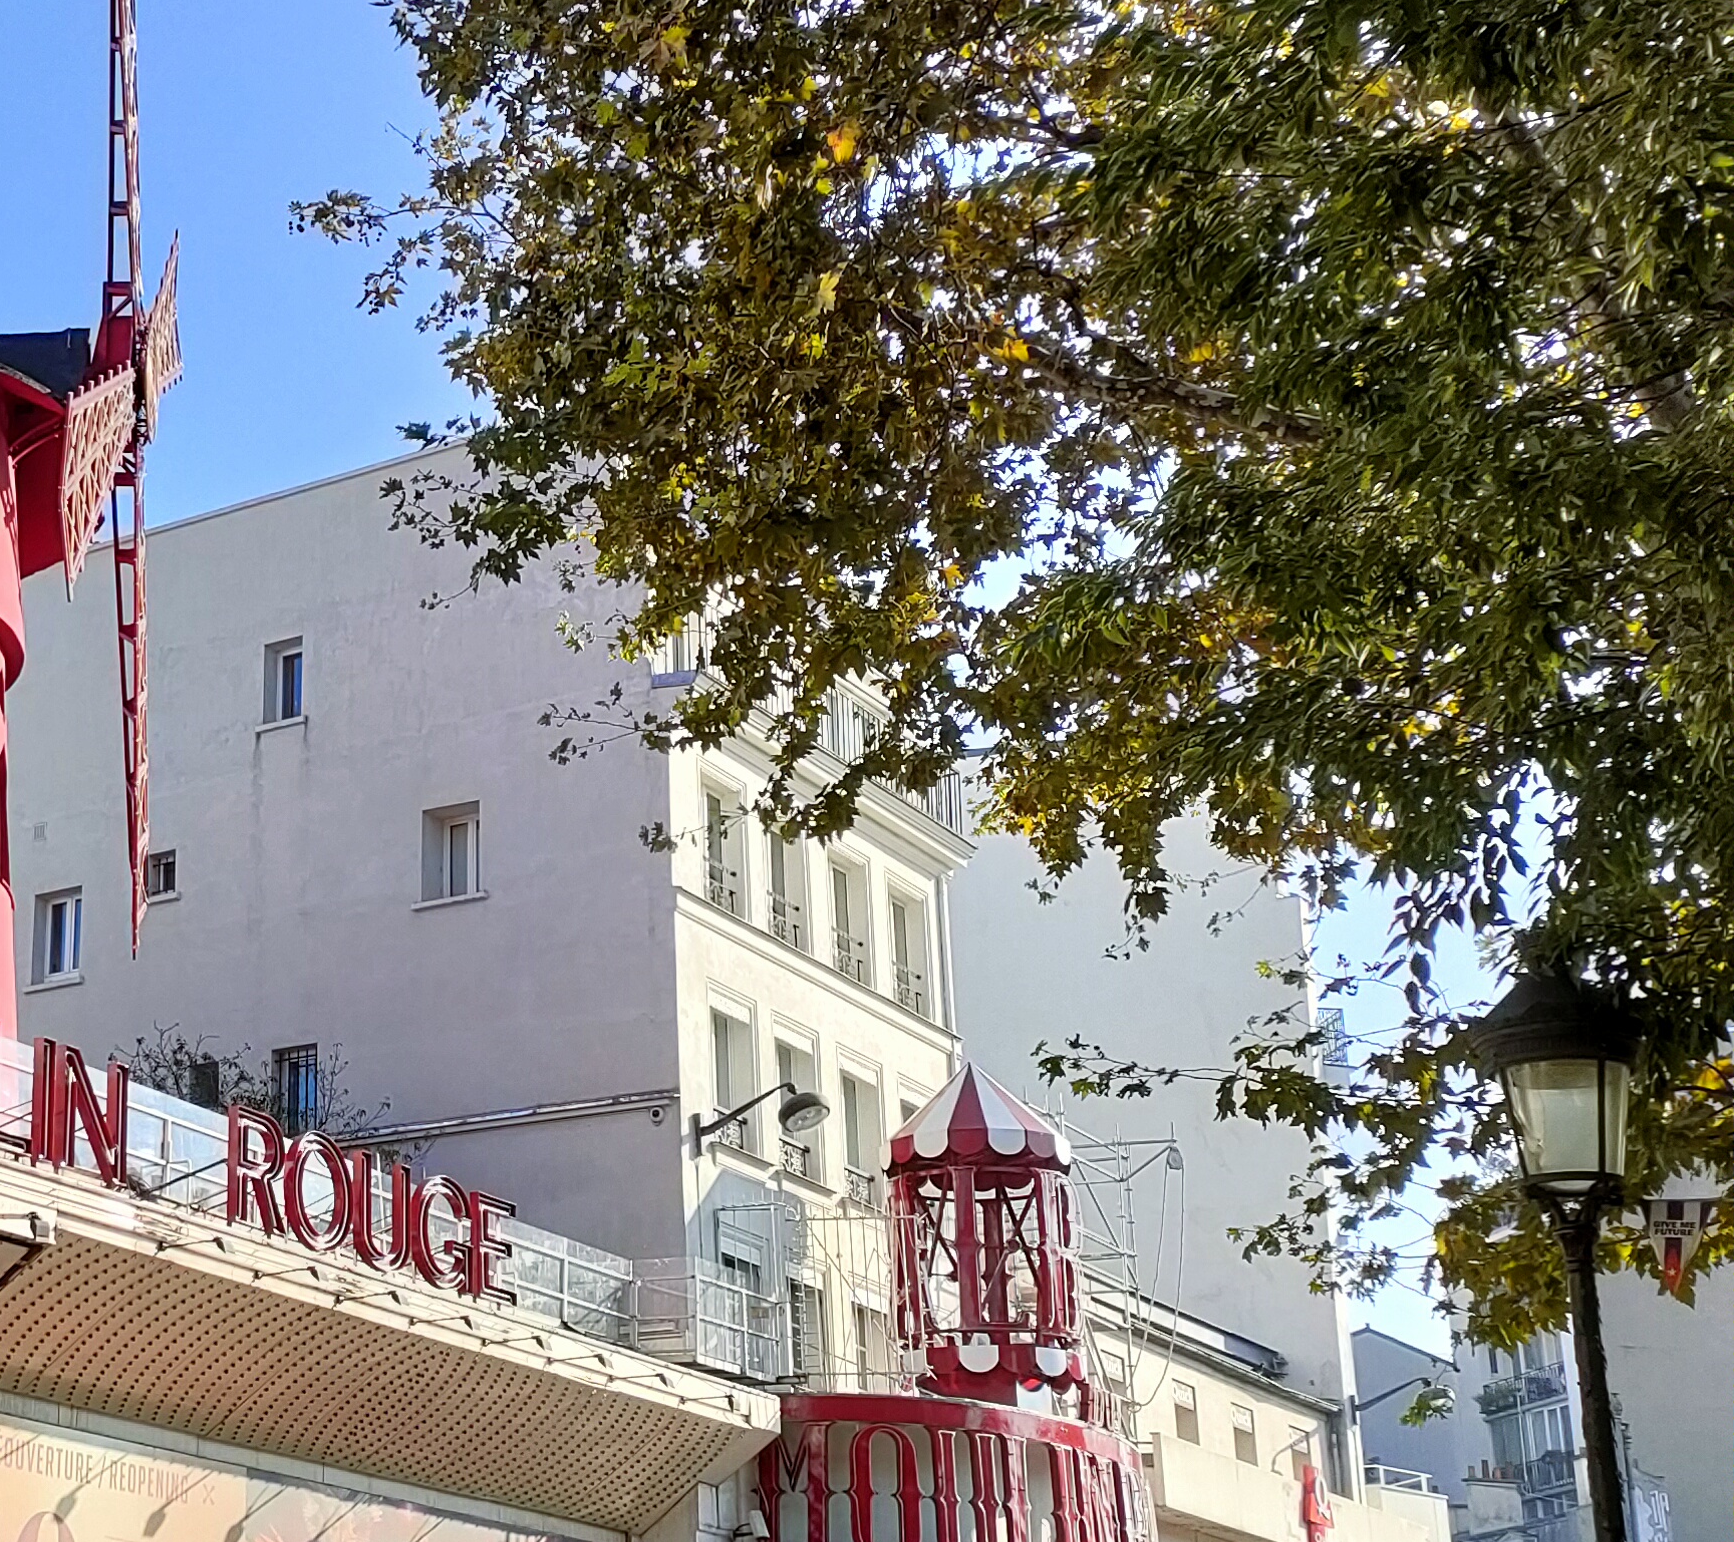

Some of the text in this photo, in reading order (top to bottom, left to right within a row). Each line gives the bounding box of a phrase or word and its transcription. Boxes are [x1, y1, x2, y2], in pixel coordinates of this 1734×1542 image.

[227, 1104, 518, 1306] ROUGE
[1653, 1221, 1696, 1229] GIVE ME
[1654, 1228, 1694, 1236] FUTURE
[109, 1460, 189, 1504] REOPENING
